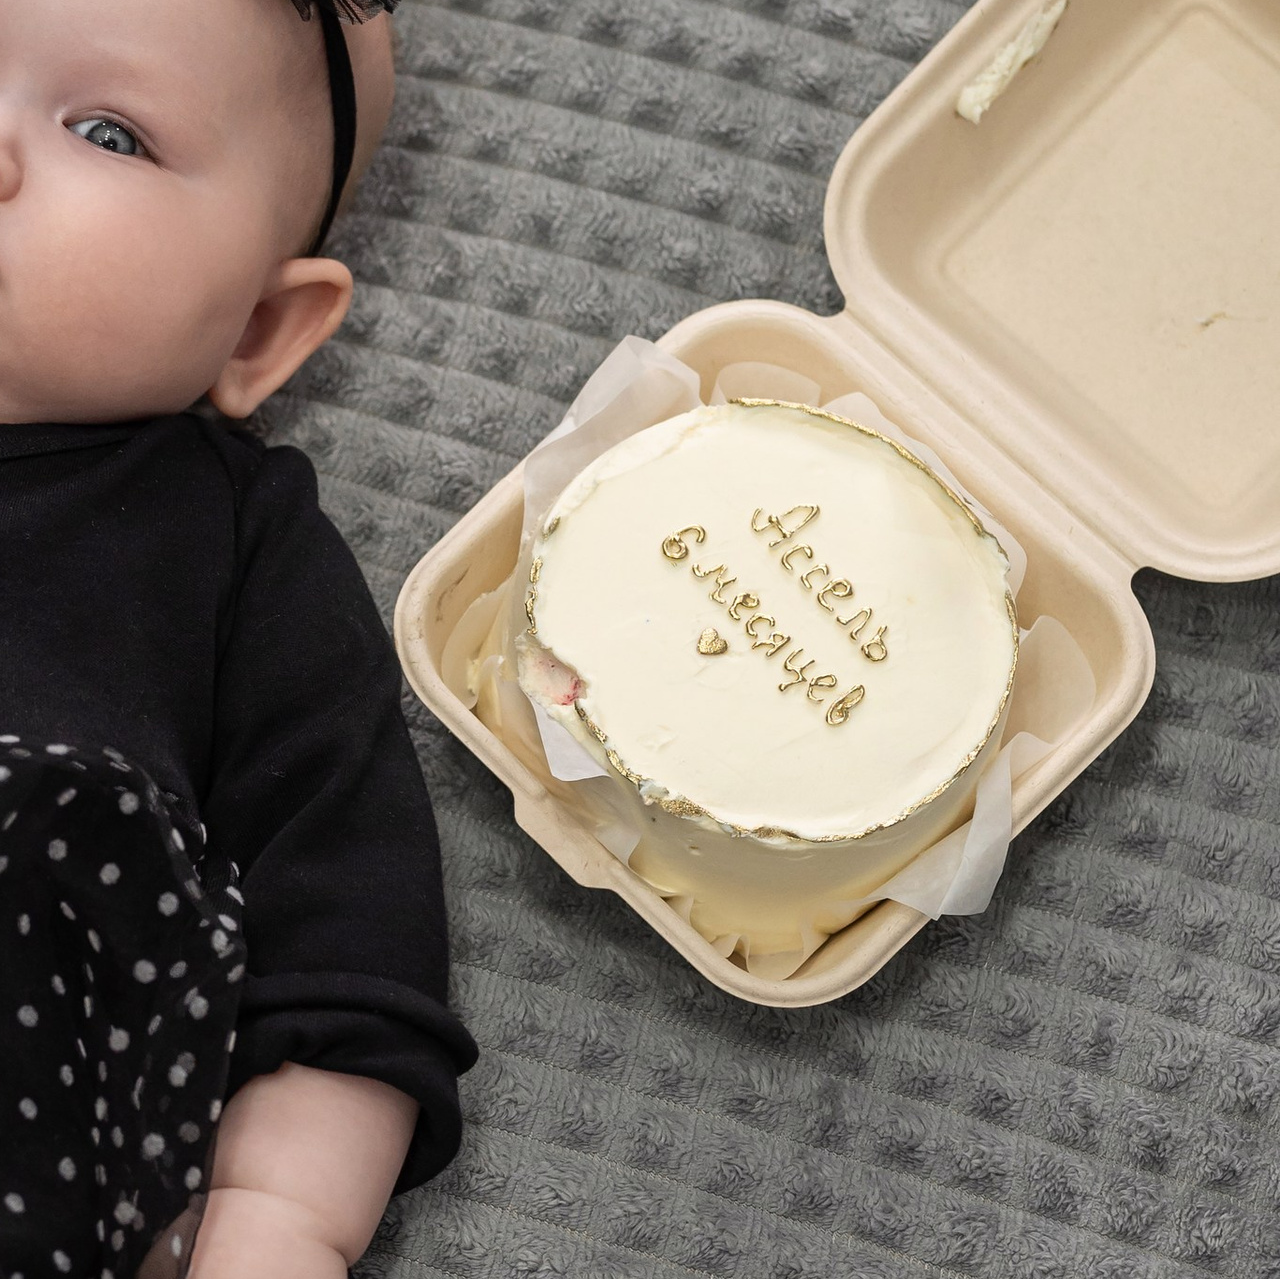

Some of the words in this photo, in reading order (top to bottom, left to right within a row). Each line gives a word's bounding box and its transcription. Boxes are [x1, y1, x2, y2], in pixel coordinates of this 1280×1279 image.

[661, 524, 706, 560] 6
[691, 563, 865, 726] месяцев
[751, 504, 888, 662] Ассель
